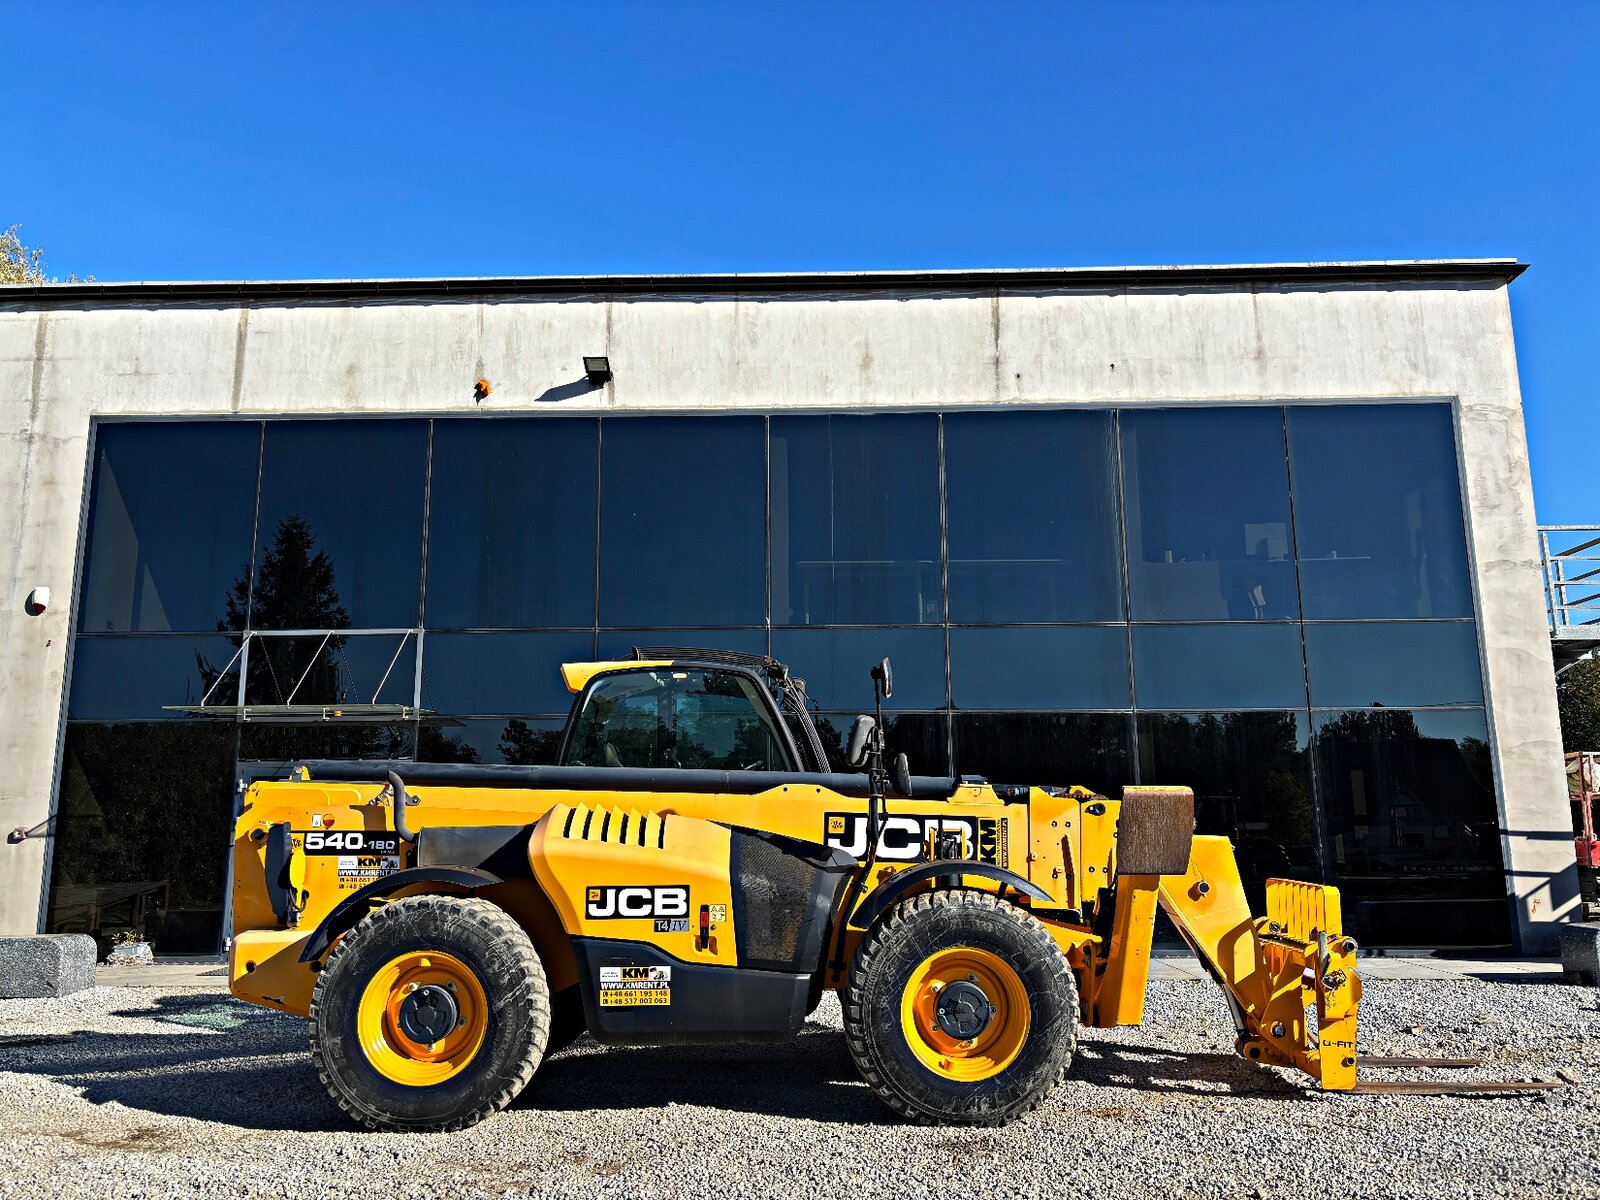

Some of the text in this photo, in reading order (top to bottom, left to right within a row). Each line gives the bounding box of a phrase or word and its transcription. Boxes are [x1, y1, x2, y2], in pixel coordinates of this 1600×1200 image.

[357, 858, 381, 867] KM
[588, 888, 688, 916] JCB
[655, 920, 668, 931] T4
[622, 967, 650, 978] KM
[600, 981, 670, 990] WWW.KMRENT.PL
[609, 990, 623, 998] +48
[623, 990, 637, 998] 661
